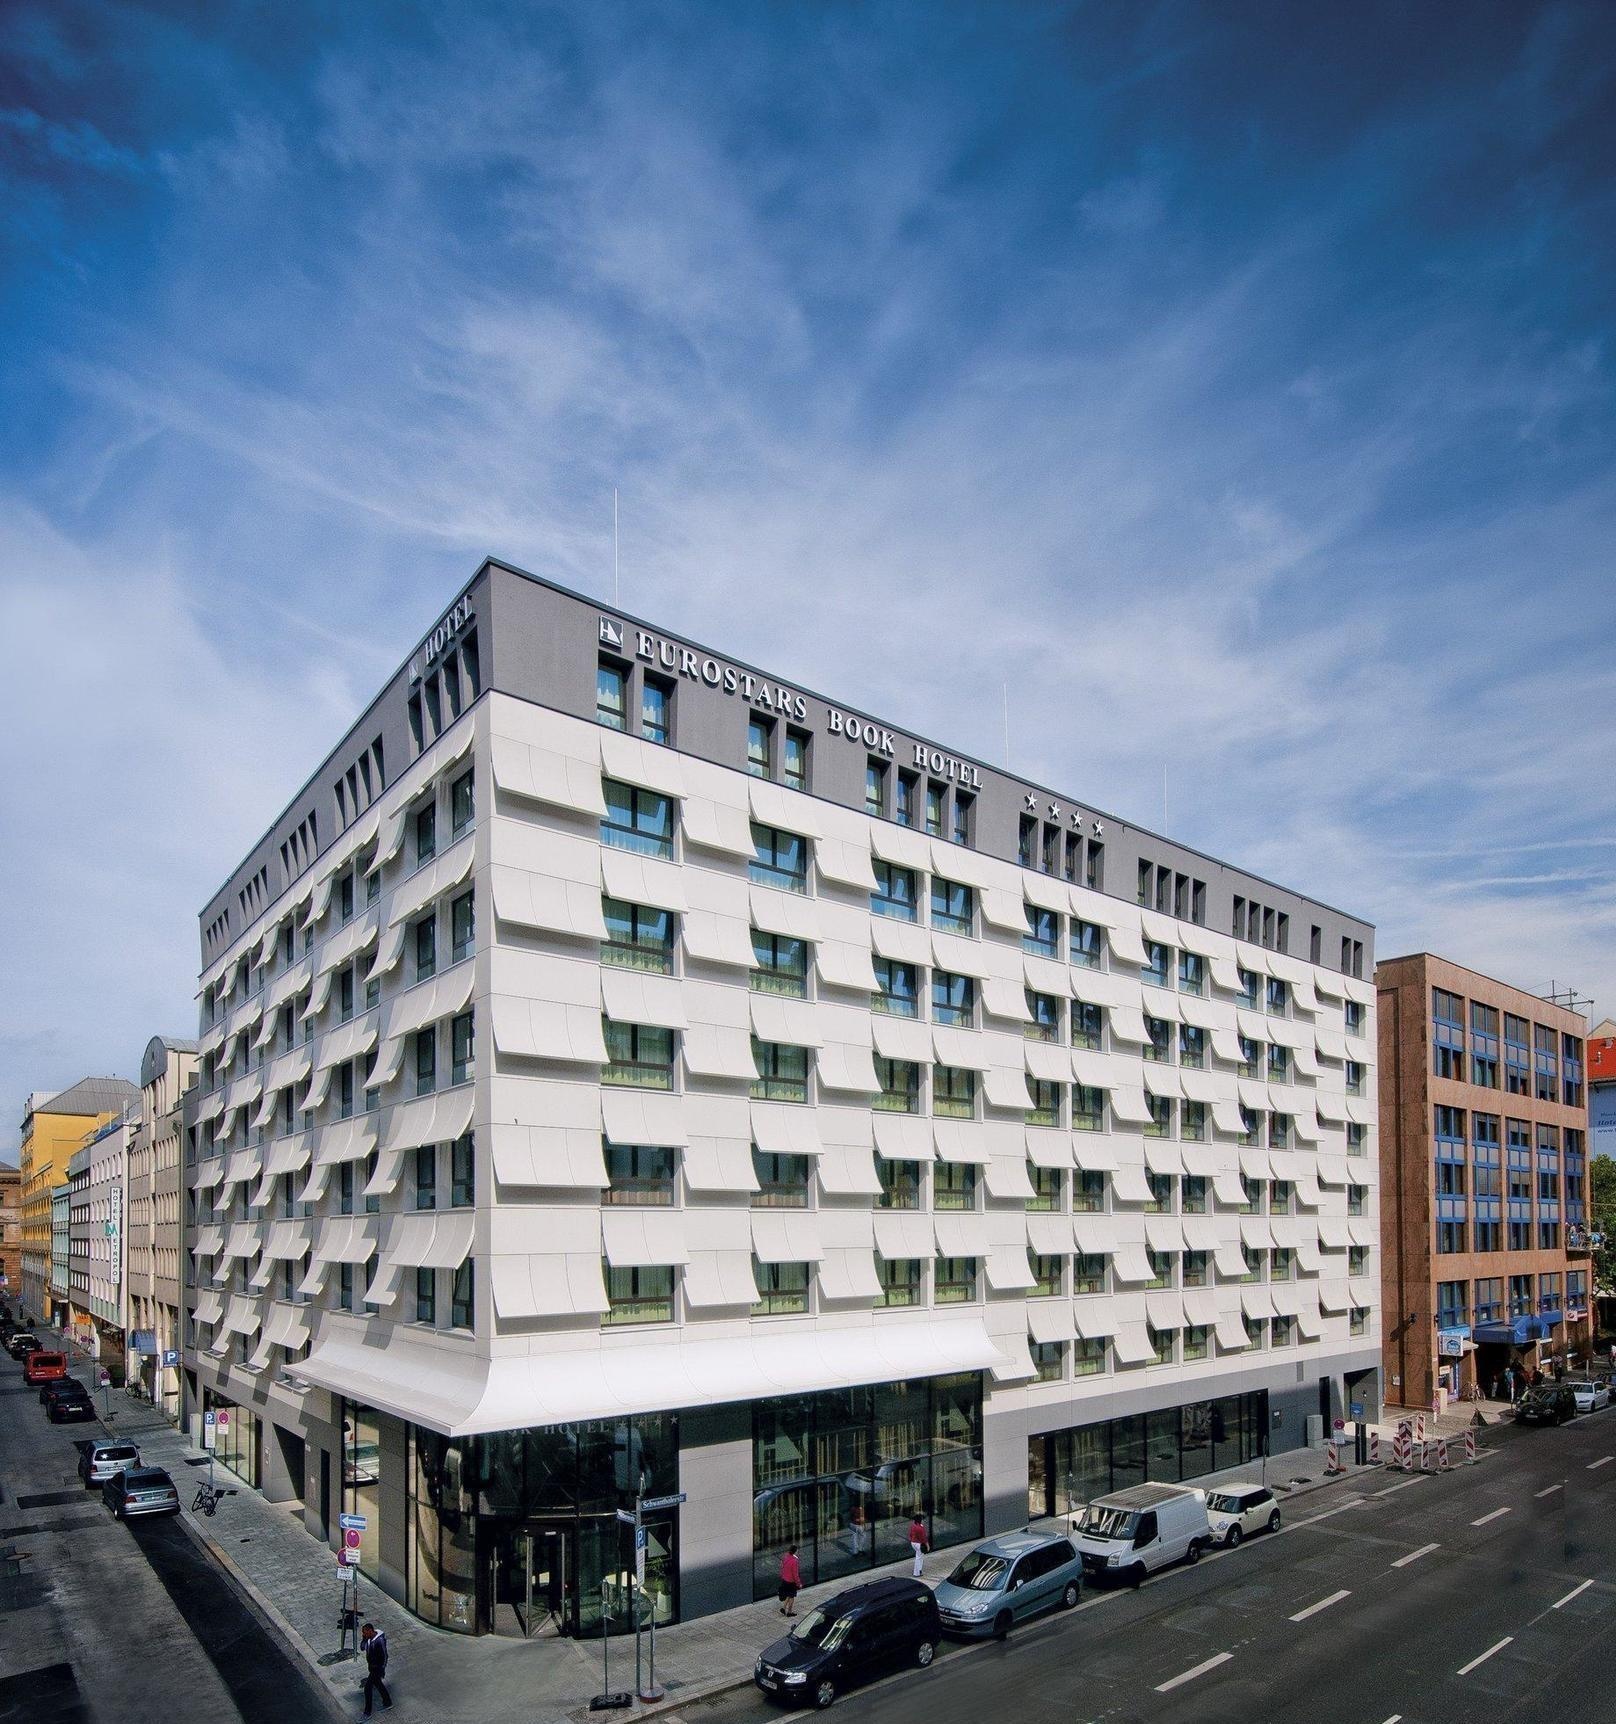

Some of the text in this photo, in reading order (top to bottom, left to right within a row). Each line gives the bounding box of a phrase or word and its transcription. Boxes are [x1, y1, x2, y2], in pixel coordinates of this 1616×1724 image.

[425, 594, 474, 665] HOTEL
[637, 631, 984, 789] EUROSTARS BOOK HOTEL
